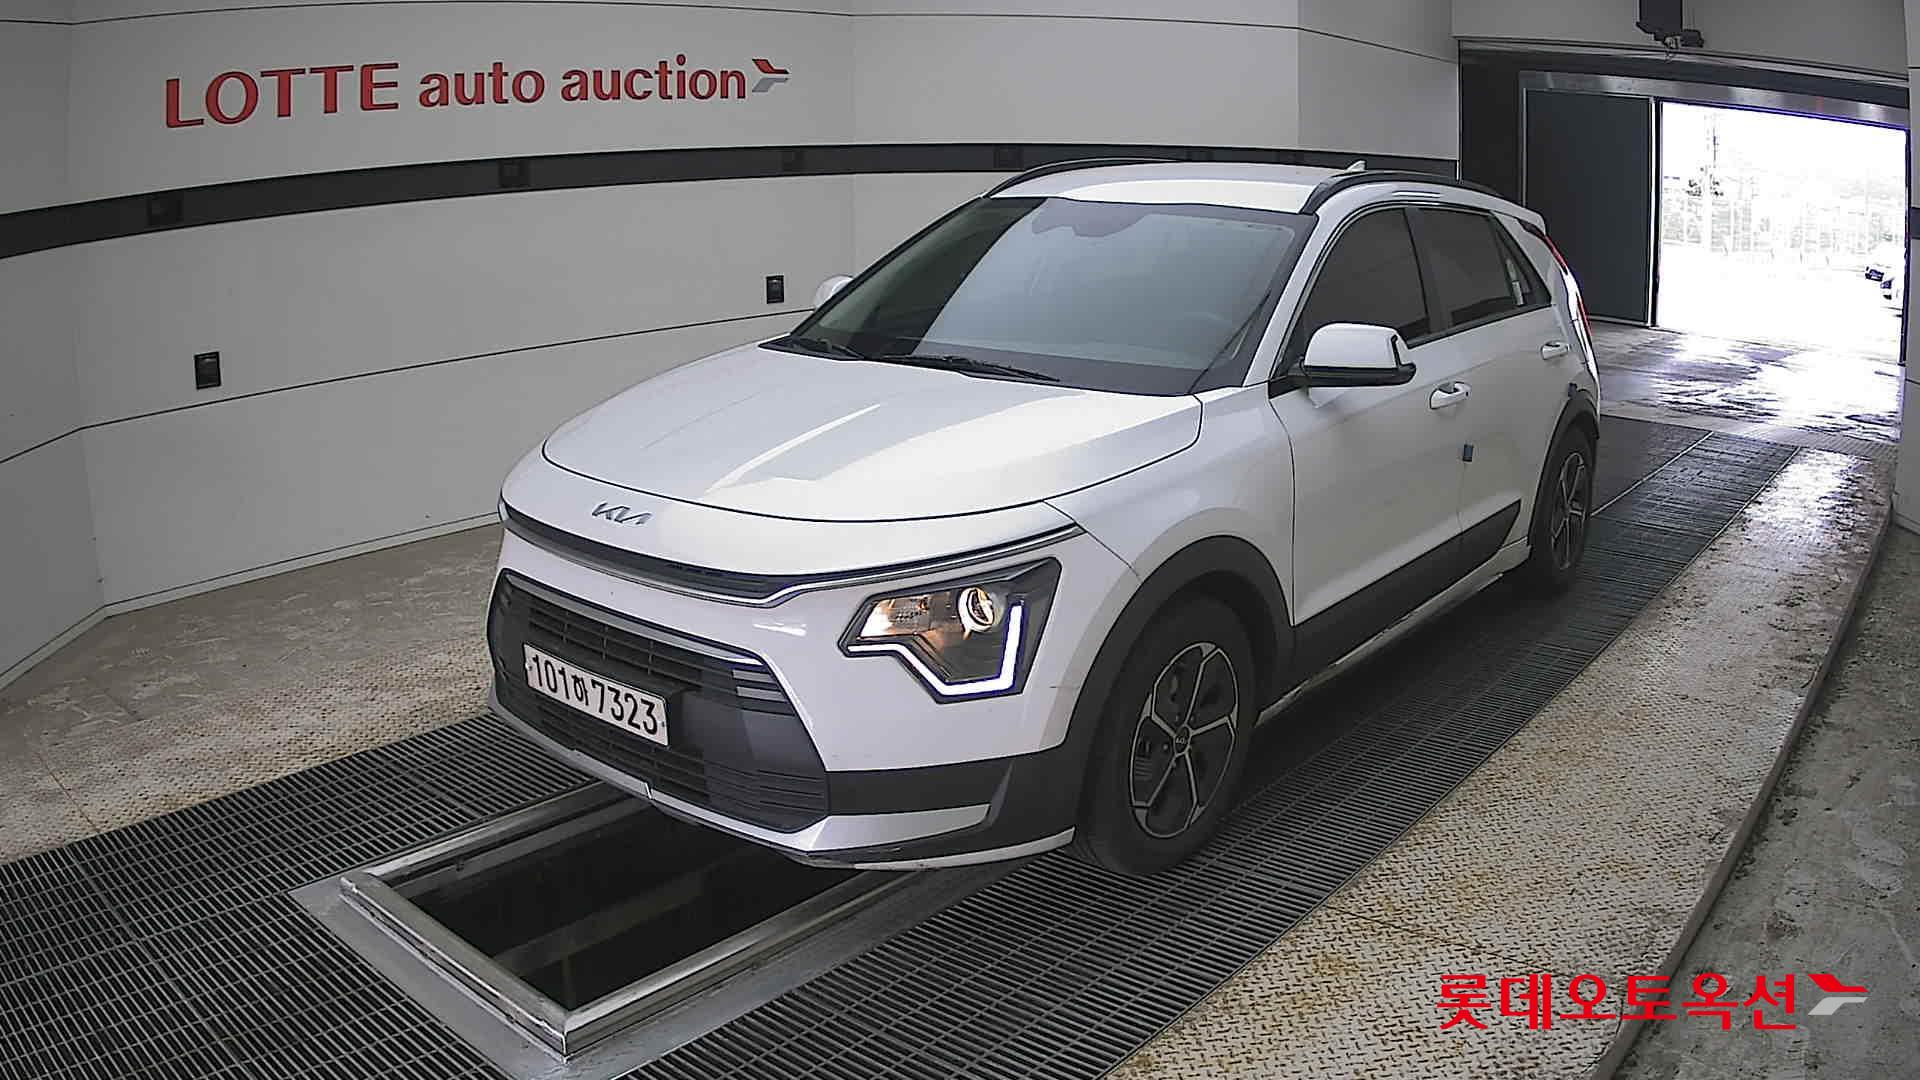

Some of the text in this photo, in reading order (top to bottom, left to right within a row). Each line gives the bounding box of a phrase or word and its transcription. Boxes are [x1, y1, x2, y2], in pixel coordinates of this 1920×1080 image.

[165, 54, 747, 128] LOTTE auto auction
[591, 501, 652, 525] KIA
